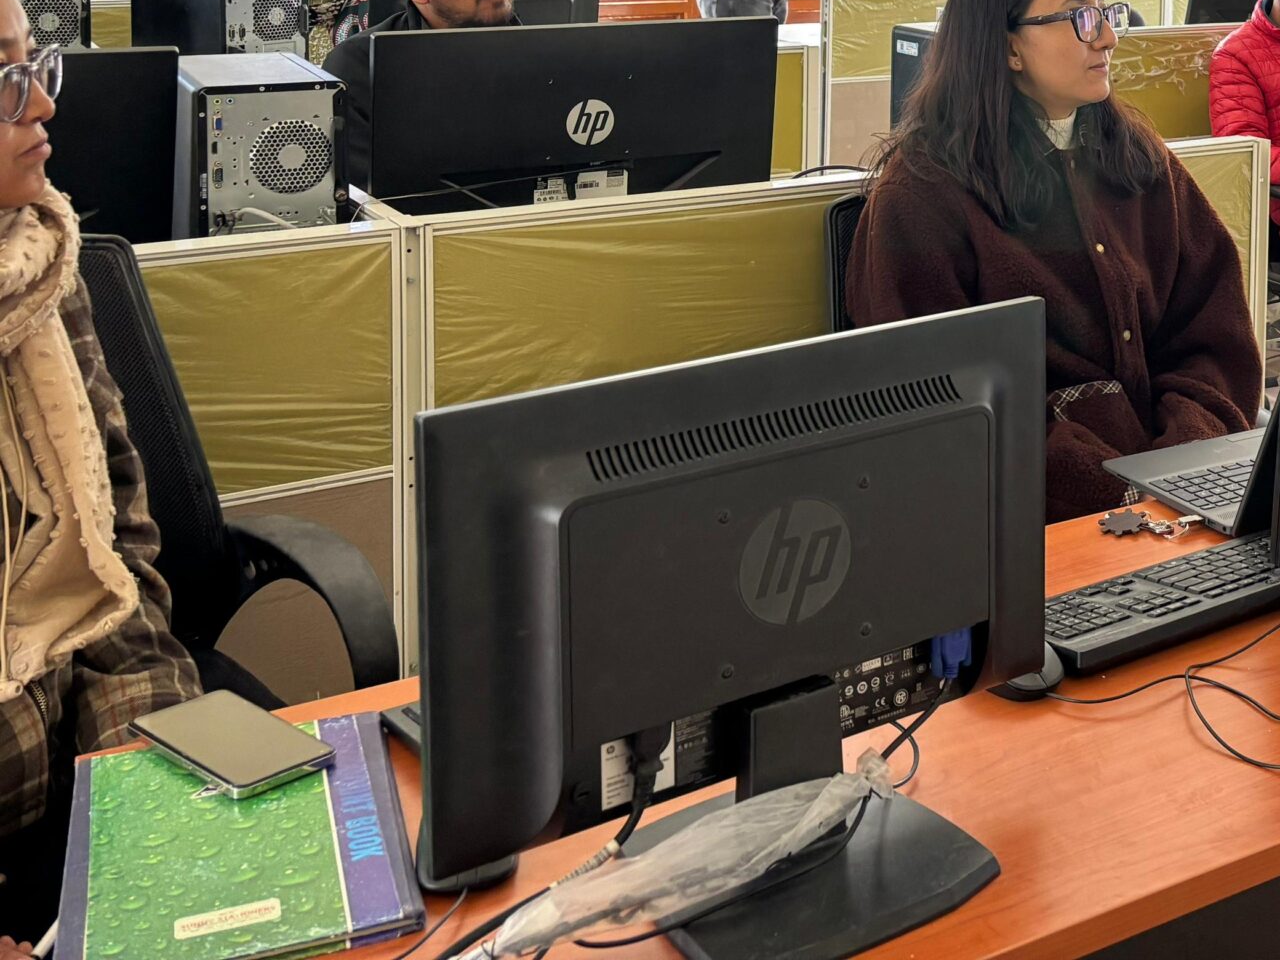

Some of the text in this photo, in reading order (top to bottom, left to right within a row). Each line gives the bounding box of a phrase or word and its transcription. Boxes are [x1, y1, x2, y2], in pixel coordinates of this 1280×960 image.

[570, 99, 611, 146] hp
[753, 500, 843, 625] hp
[346, 815, 384, 862] BOOK
